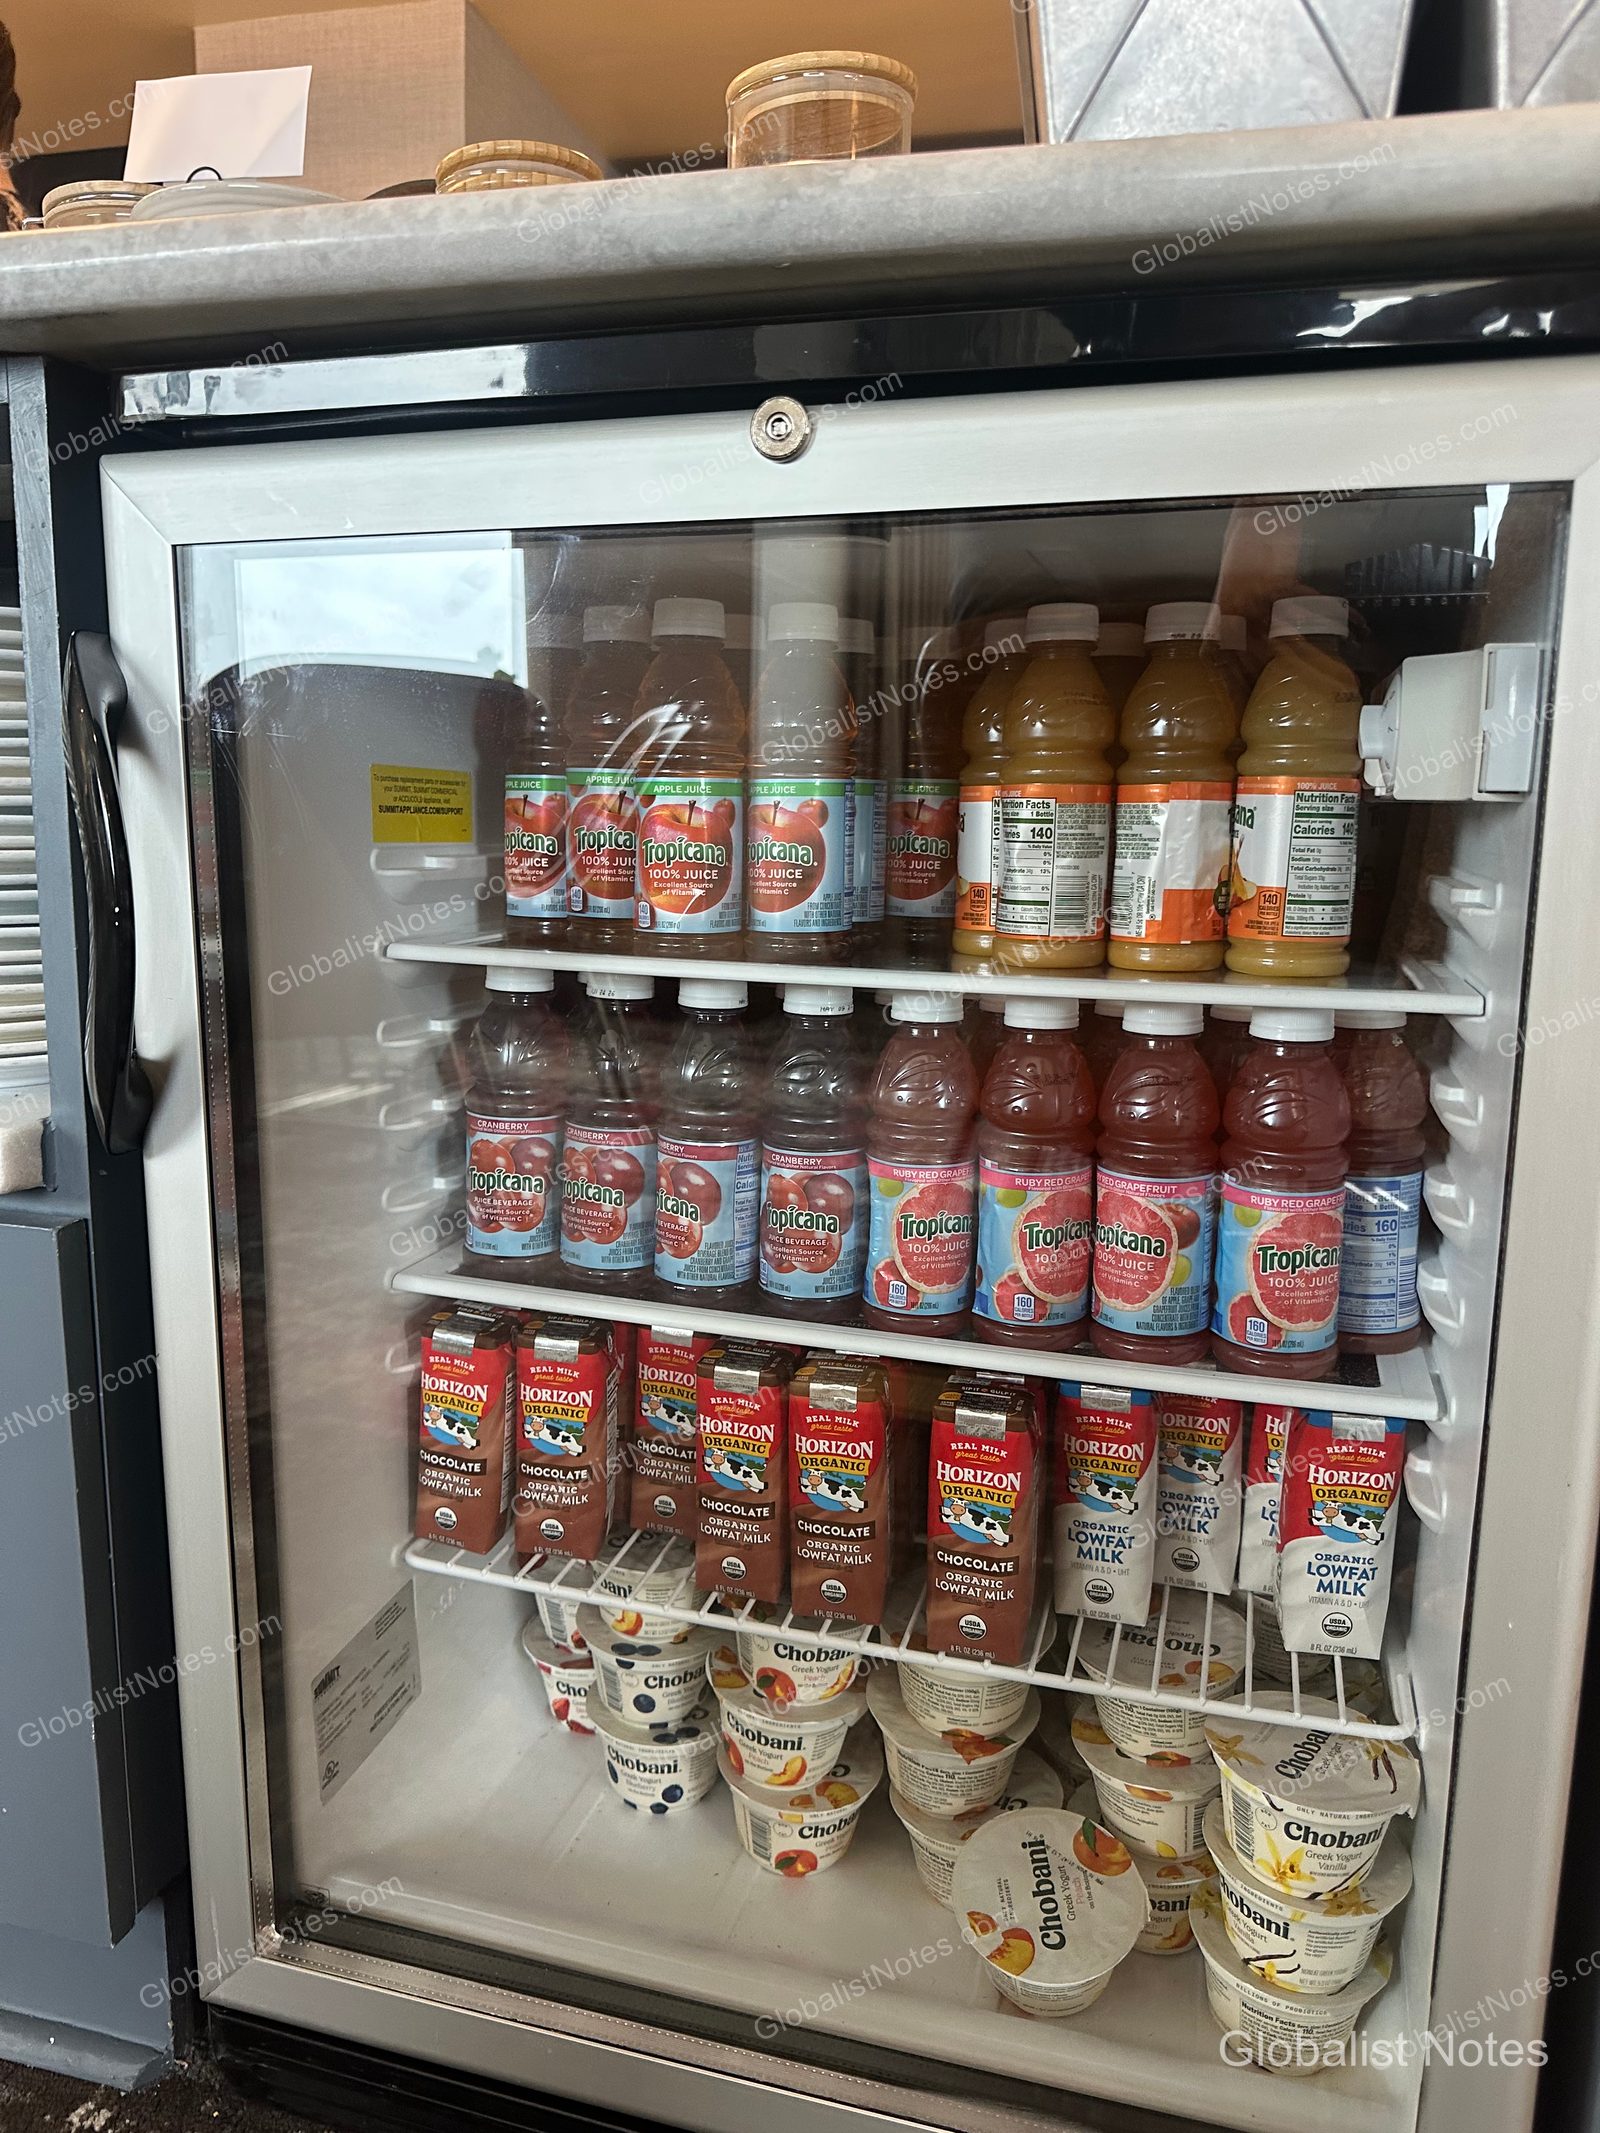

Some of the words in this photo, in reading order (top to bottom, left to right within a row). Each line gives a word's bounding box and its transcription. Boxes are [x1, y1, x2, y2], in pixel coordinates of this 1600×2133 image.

[586, 775, 612, 783] APPLE
[654, 785, 680, 793] APPLE
[684, 785, 711, 793] JUICE
[1026, 800, 1050, 809] Facts
[1296, 793, 1337, 804] Nutrition
[1295, 805, 1319, 813] Serving
[1030, 827, 1053, 839] 140
[1294, 826, 1335, 835] Calories
[1342, 823, 1354, 835] 140
[643, 836, 725, 866] Tropicana
[649, 870, 680, 879] 100%
[684, 870, 718, 880] JUICE
[768, 869, 802, 879] JUICE
[1262, 894, 1277, 904] 140
[478, 1120, 529, 1130] CRANBERRY
[772, 1154, 822, 1165] CRANBERRY
[893, 1168, 917, 1178] RUBY
[919, 1169, 938, 1178] RED
[469, 1168, 544, 1195] Tropicana
[1015, 1178, 1042, 1186] RUBY
[1044, 1177, 1062, 1186] RED
[1102, 1176, 1114, 1187] RED
[1115, 1179, 1177, 1194] GRAPEFRUIT
[493, 1198, 533, 1206] BEVERAGE
[1251, 1196, 1279, 1207] RUBY
[1281, 1197, 1304, 1208] RED
[1375, 1218, 1397, 1233] 160
[769, 1235, 784, 1244] JUICE
[786, 1237, 827, 1246] BEVERAGE
[909, 1243, 939, 1253] 100%
[943, 1240, 969, 1251] JUICE
[928, 1261, 955, 1269] Vitamin
[891, 1283, 905, 1295] 160
[1269, 1278, 1305, 1288] 100%
[1016, 1297, 1032, 1308] 160
[1248, 1320, 1265, 1332] 160
[421, 1373, 488, 1402] HORIZON
[521, 1383, 593, 1407] HORIZON
[425, 1392, 479, 1413] ORGANIC
[525, 1403, 585, 1419] ORGANIC
[699, 1414, 774, 1442] HORIZON
[705, 1436, 766, 1454] ORGANIC
[795, 1433, 874, 1459] HORIZON
[950, 1442, 977, 1451] REAL
[982, 1443, 1008, 1458] MILK
[1064, 1434, 1145, 1461] HORIZON
[420, 1449, 481, 1472] CHOCOLATE
[801, 1456, 866, 1472] ORGANIC
[954, 1450, 978, 1461] great
[980, 1453, 1001, 1463] taste
[521, 1464, 588, 1480] CHOCOLATE
[1071, 1456, 1137, 1474] ORGANIC
[937, 1460, 1021, 1491] HORIZON
[1307, 1464, 1396, 1490] HORIZON
[419, 1476, 454, 1493] LOWFAT
[456, 1484, 482, 1497] MILK
[943, 1484, 1012, 1505] ORGANIC
[1315, 1488, 1388, 1504] ORGANIC
[701, 1498, 770, 1518] CHOCOLATE
[797, 1519, 870, 1537] CHOCOLATE
[1073, 1519, 1129, 1534] ORGANIC
[1068, 1528, 1135, 1550] LOWFAT
[937, 1550, 1014, 1573] CHOCOLATE
[1076, 1545, 1124, 1564] MILK
[1314, 1553, 1374, 1565] ORGANIC
[1307, 1561, 1379, 1581] LOWFAT
[946, 1572, 1003, 1588] ORGANIC
[1316, 1579, 1367, 1597] MILK
[935, 1579, 982, 1600] LOWFAT
[985, 1587, 1015, 1601] MILK
[1324, 1645, 1332, 1653] OZ
[1333, 1645, 1345, 1654] (236
[1346, 1646, 1357, 1655] mL)
[791, 1665, 813, 1674] Greek
[815, 1664, 840, 1675] Yogurt
[726, 1711, 803, 1751] Chobani
[607, 1744, 679, 1775] Chobani
[1283, 1821, 1384, 1849] Chobani
[1305, 1850, 1333, 1861] Greek
[1336, 1851, 1362, 1863] Yogurt
[1319, 1861, 1347, 1871] Vanilla
[1058, 1865, 1071, 1892] Yogurt
[1021, 1839, 1066, 1951] Chobani
[1063, 1893, 1076, 1921] Greek
[1236, 1983, 1268, 2004] BILLIONS
[1241, 2002, 1280, 2022] Nutrition
[1275, 2016, 1296, 2028] Facts
